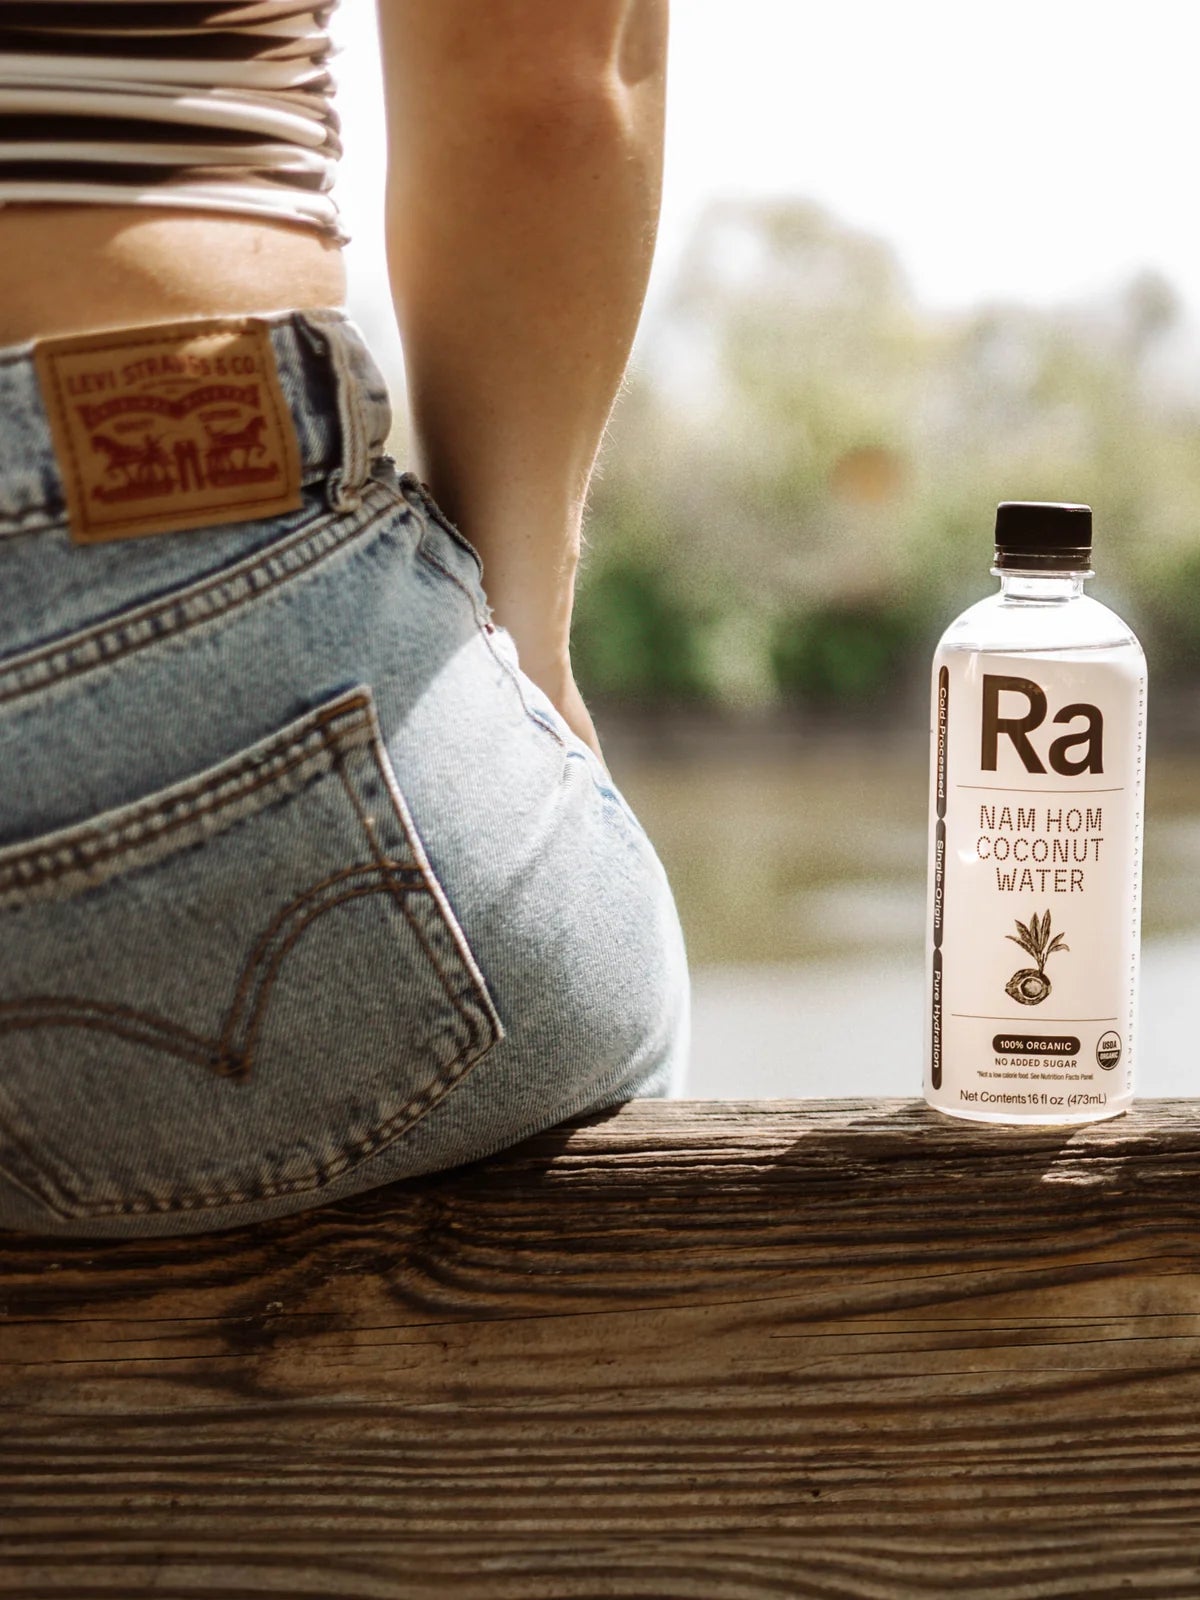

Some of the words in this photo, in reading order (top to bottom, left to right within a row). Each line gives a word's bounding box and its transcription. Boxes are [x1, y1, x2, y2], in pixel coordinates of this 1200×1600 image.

[67, 369, 117, 396] LEVI
[981, 674, 1104, 776] Ra
[938, 687, 947, 799] Cold-Processed
[980, 805, 1036, 832] NAM
[1047, 808, 1102, 832] HOM
[977, 835, 1104, 862] COCONUT
[934, 839, 944, 929] Single-Origin
[996, 867, 1084, 892] WATER
[933, 1005, 941, 1068] Hydration
[1000, 1040, 1024, 1049] 100%
[1026, 1041, 1072, 1050] ORGANIC
[1102, 1041, 1117, 1050] USDA
[995, 1058, 1008, 1066] NO
[1010, 1058, 1040, 1067] ADDED
[1043, 1060, 1077, 1068] SUGAR
[960, 1090, 978, 1102] Net
[980, 1091, 1026, 1104] Contents
[1028, 1094, 1039, 1104] 16
[1040, 1094, 1047, 1104] fl
[1049, 1096, 1064, 1105] oz
[1067, 1093, 1107, 1107] (473mL)
